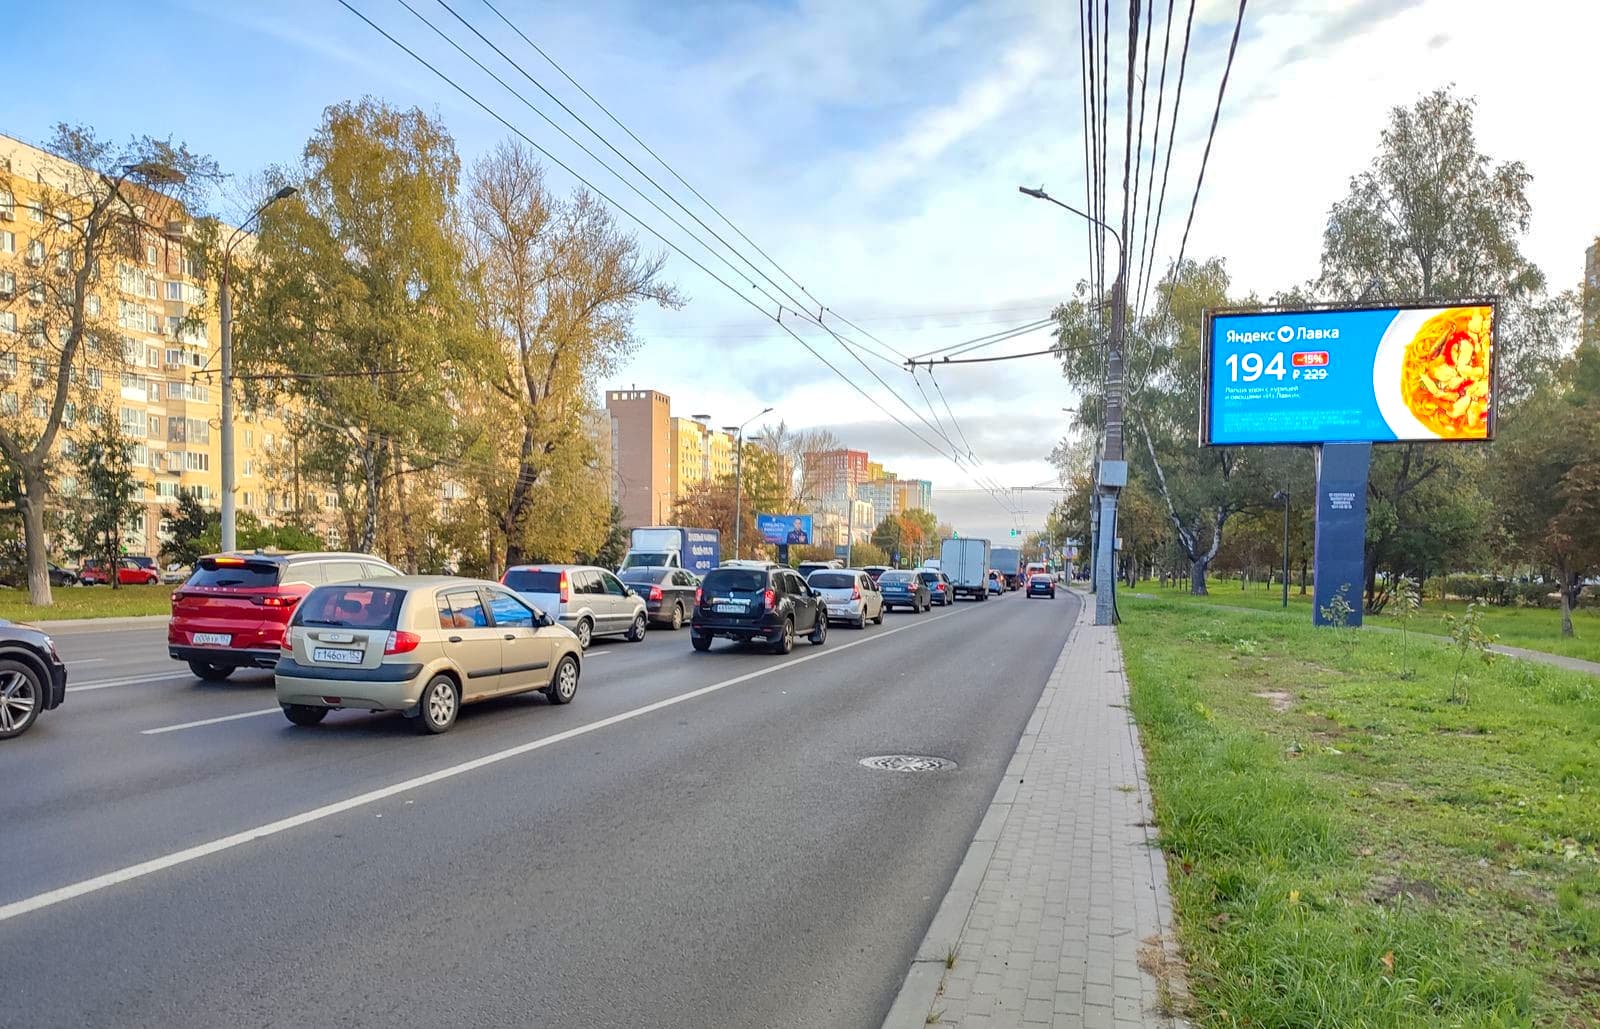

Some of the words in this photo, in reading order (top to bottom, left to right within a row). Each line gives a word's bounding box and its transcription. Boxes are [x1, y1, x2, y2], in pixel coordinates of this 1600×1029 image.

[1226, 329, 1275, 344] Яндекс
[1297, 326, 1339, 340] Лавка
[1225, 352, 1287, 382] 194
[1303, 369, 1328, 380] 229
